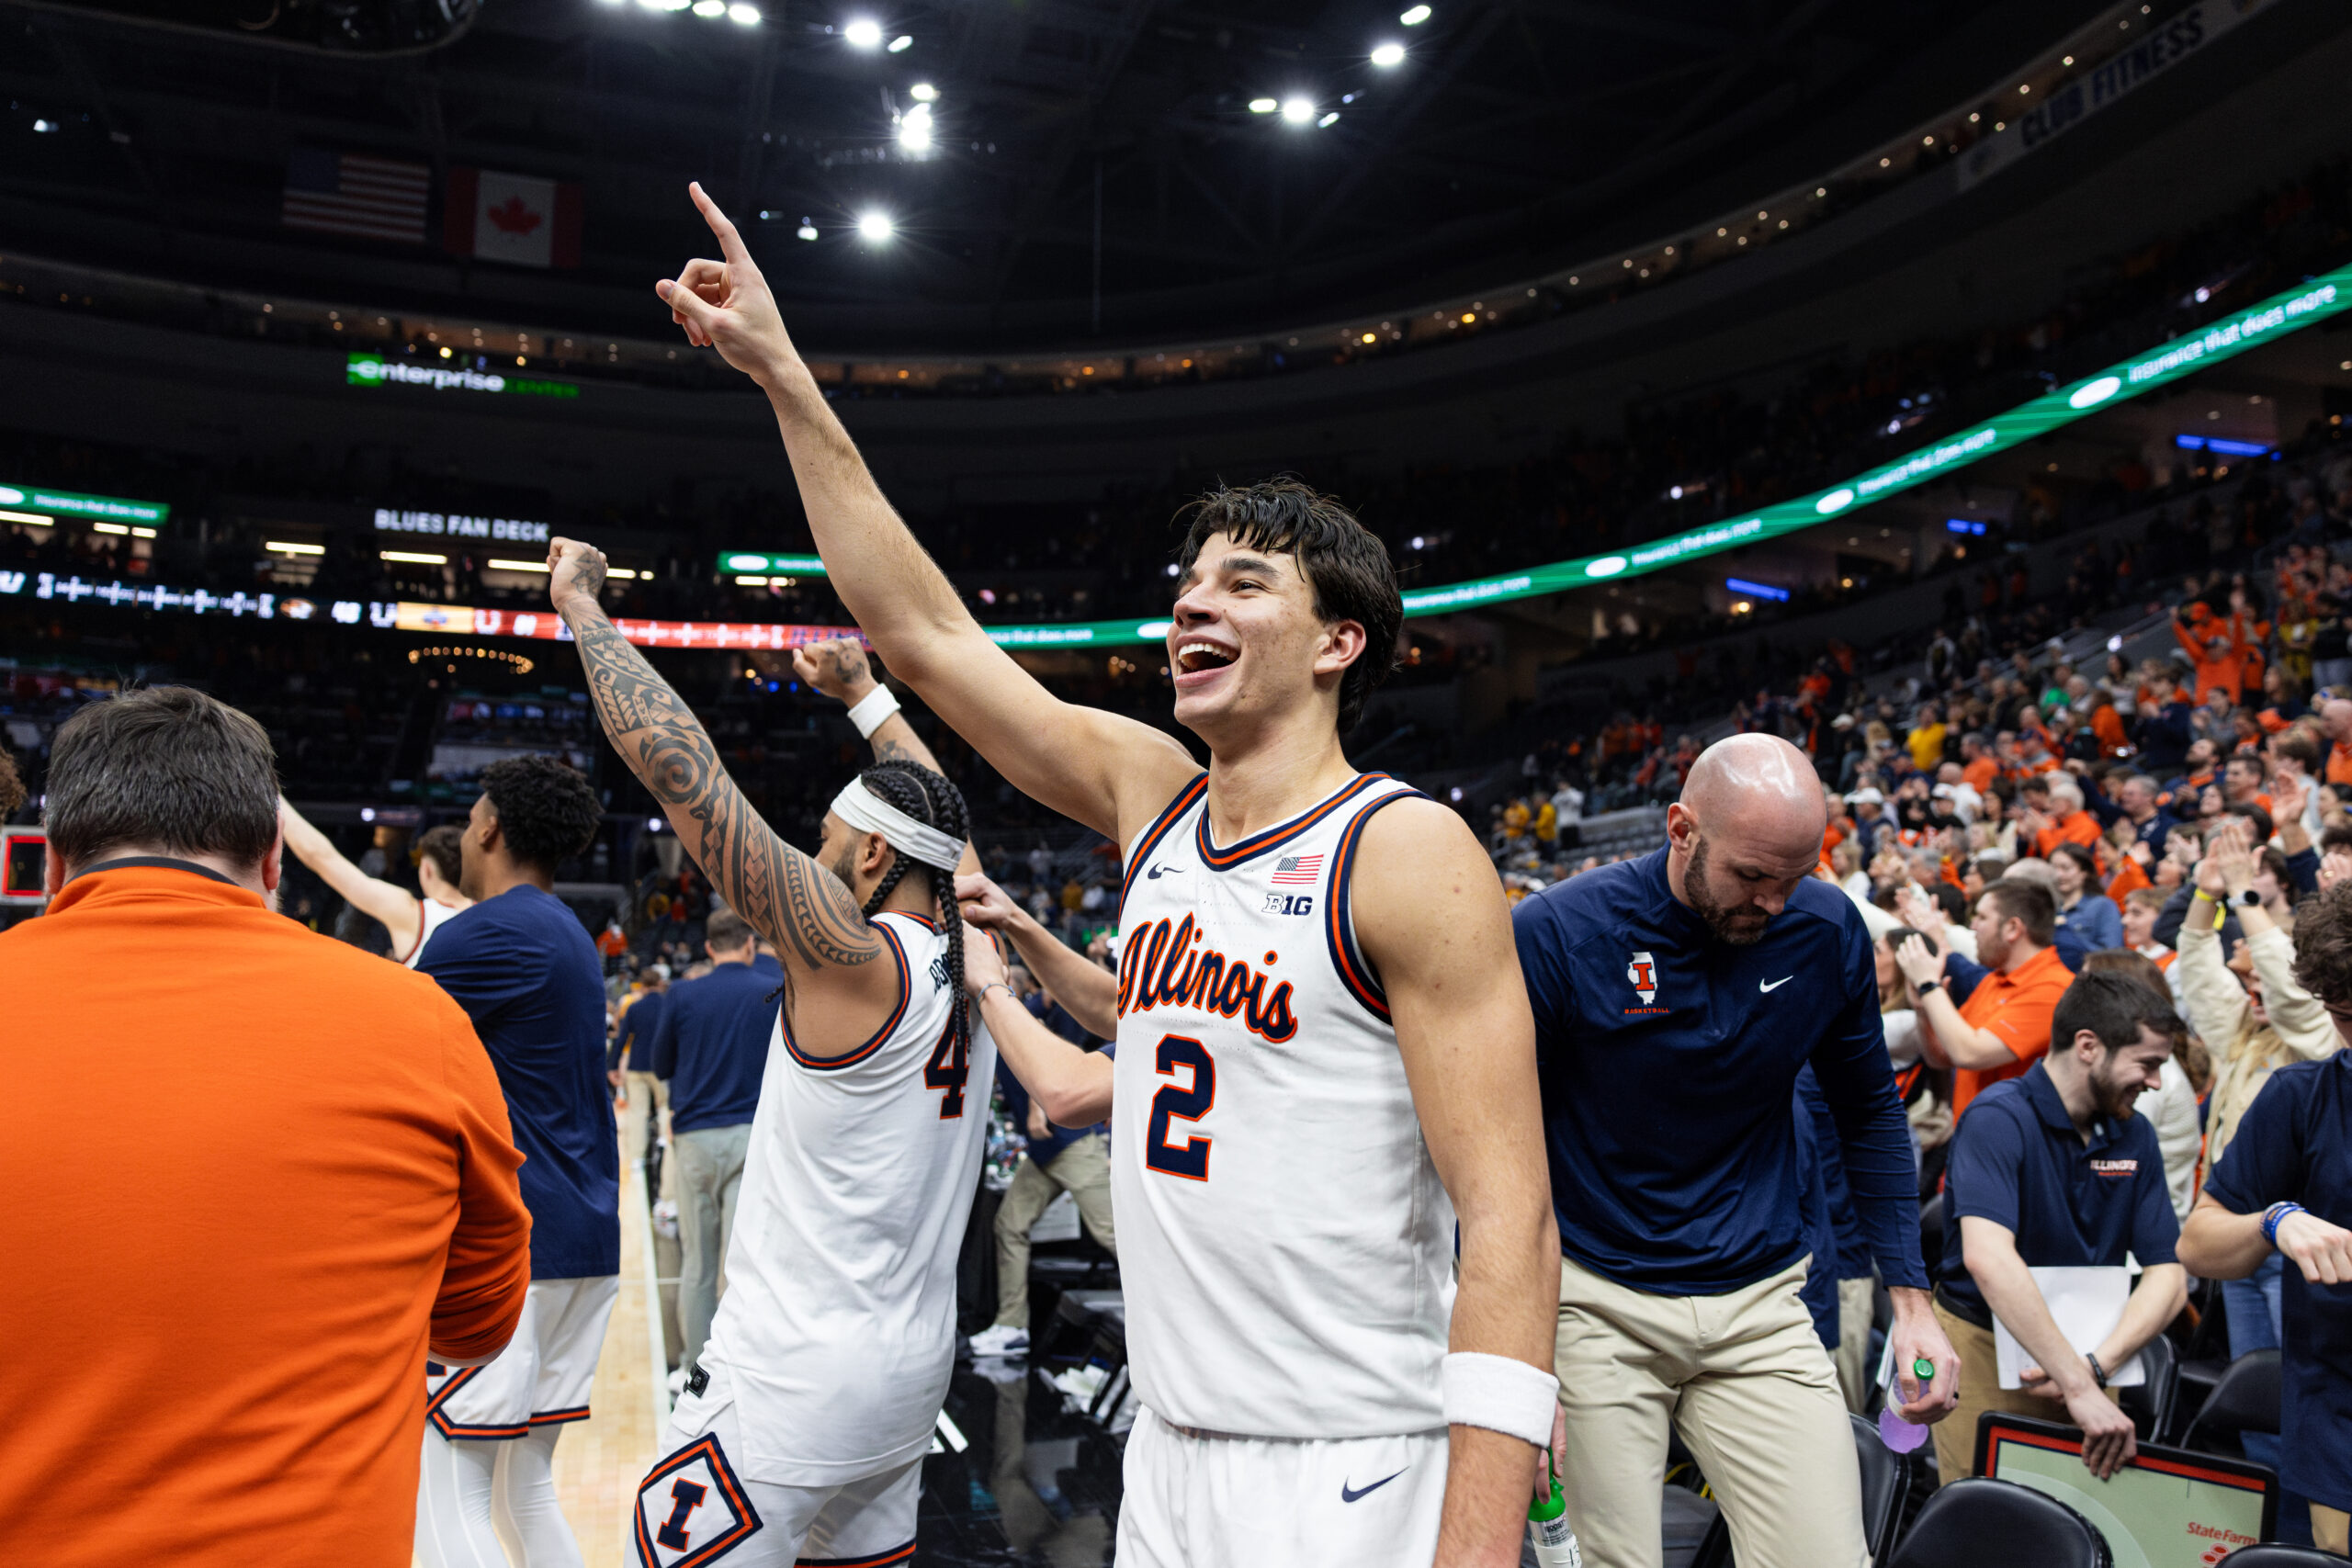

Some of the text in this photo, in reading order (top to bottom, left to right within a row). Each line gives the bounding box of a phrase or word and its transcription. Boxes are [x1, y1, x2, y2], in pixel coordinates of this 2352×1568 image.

[2093, 9, 2203, 102] FITNESS
[2205, 322, 2241, 353] that
[2241, 306, 2285, 337] does
[2285, 285, 2336, 318] more
[347, 360, 504, 392] enterprise
[374, 508, 549, 542] BLUES FAN DECK
[1118, 911, 1297, 1043] Illinois
[923, 998, 970, 1121] 4
[1146, 1033, 1216, 1182] 2
[2090, 1159, 2138, 1171] ILLINOIS
[656, 1477, 708, 1552] I
